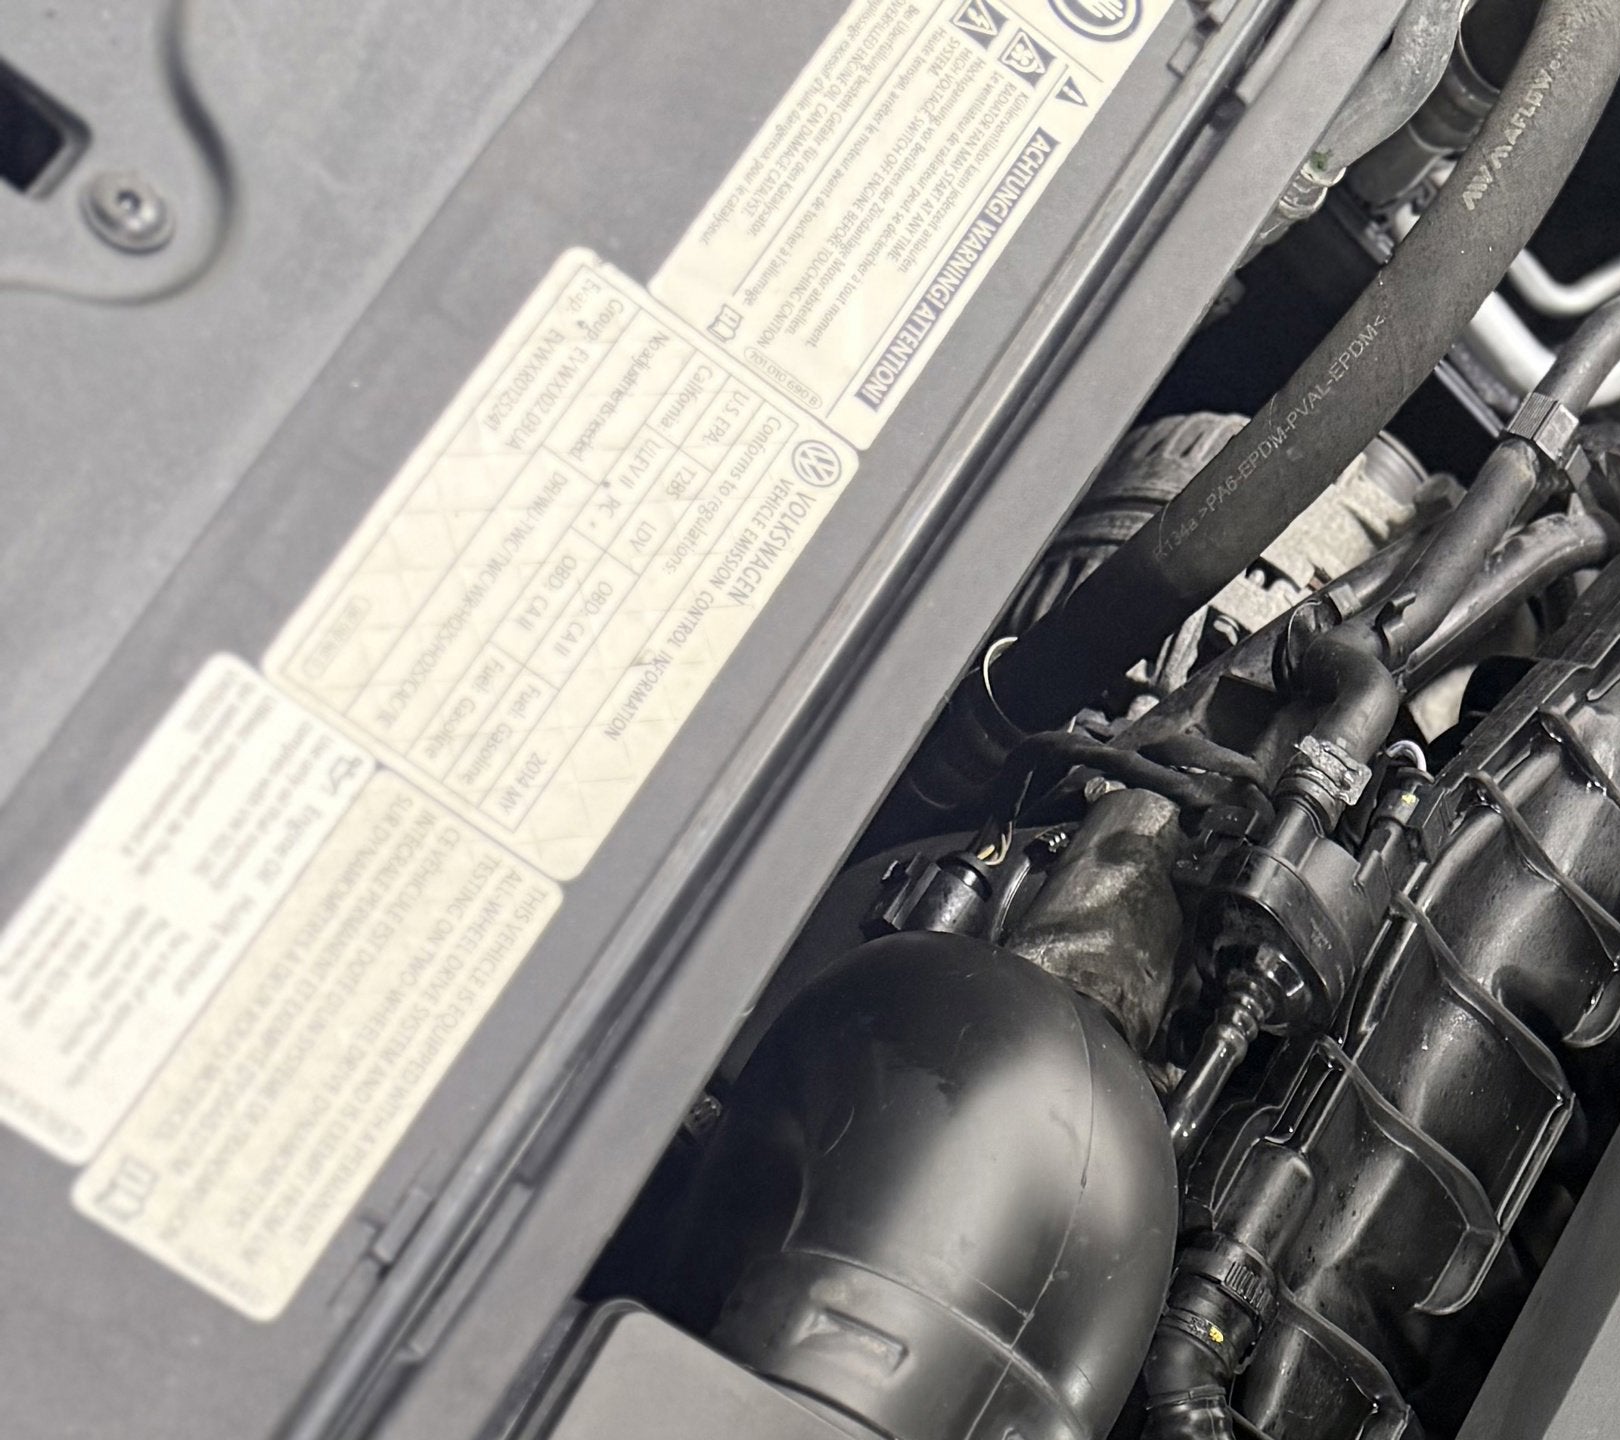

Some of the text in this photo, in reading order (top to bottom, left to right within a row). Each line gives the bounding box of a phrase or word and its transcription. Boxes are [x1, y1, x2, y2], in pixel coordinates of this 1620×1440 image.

[900, 3, 920, 24] Bei
[815, 35, 852, 80] excessif
[918, 24, 947, 58] Haute
[946, 45, 973, 76] HIGH
[834, 44, 869, 87] ENGINE
[987, 69, 1004, 86] Le
[822, 80, 844, 104] OIL
[835, 72, 871, 116] besteht
[953, 79, 997, 136] ventilateur
[976, 79, 1017, 131] RADIATOR
[755, 105, 802, 164] dangereux
[804, 99, 830, 129] CAN
[811, 108, 845, 149] Gefahr
[863, 120, 880, 137] le
[917, 123, 936, 144] vor
[774, 122, 814, 172] DAMAGE
[799, 143, 821, 166] für
[838, 130, 873, 173] moteur
[890, 113, 926, 157] SWITCH
[943, 129, 963, 149] de
[962, 124, 986, 151] FAN
[738, 157, 762, 184] pour
[785, 159, 810, 186] den
[876, 150, 900, 176] OFF
[887, 139, 927, 190] Berühren
[914, 142, 953, 191] radiateur
[947, 145, 972, 174] MAY
[809, 193, 829, 214] de
[818, 166, 848, 200] avant
[851, 169, 886, 213] ENGINE
[875, 183, 897, 206] der
[895, 89, 1030, 278] Kühlerventilator kann jederzeit anlaufen.
[895, 183, 924, 215] peut
[927, 167, 957, 203] START
[889, 209, 905, 225] se
[902, 209, 927, 238] ANY
[917, 196, 937, 216] AT
[782, 207, 819, 252] toucher
[825, 207, 860, 250] BEFORE
[787, 244, 834, 304] TOUCHING
[815, 255, 847, 293] Motor
[858, 132, 1054, 406] ACHTUNG! WARNING! ATTENTION!
[833, 279, 858, 307] tout
[644, 327, 672, 355] No
[755, 297, 797, 350] IGNITION
[594, 492, 622, 520] PC
[625, 518, 658, 555] LDV
[724, 486, 817, 608] VOLKSWAGEN
[493, 412, 784, 818] Conforms to regulations: 2014 MY
[523, 592, 551, 621] CA
[602, 474, 795, 743] VEHICLE EMISSION CONTROL INFORMATION
[558, 617, 587, 647] CA
[505, 681, 543, 724] Fuel:
[421, 692, 479, 765] Gasoline
[458, 718, 516, 790] Gasoline
[443, 848, 502, 922] TESTING
[509, 882, 548, 926] THIS
[465, 918, 522, 990] VEHICLE
[418, 949, 466, 1006] DRIVE
[376, 999, 431, 1068] SYSTEM
[398, 999, 466, 1088] EQUIPPED
